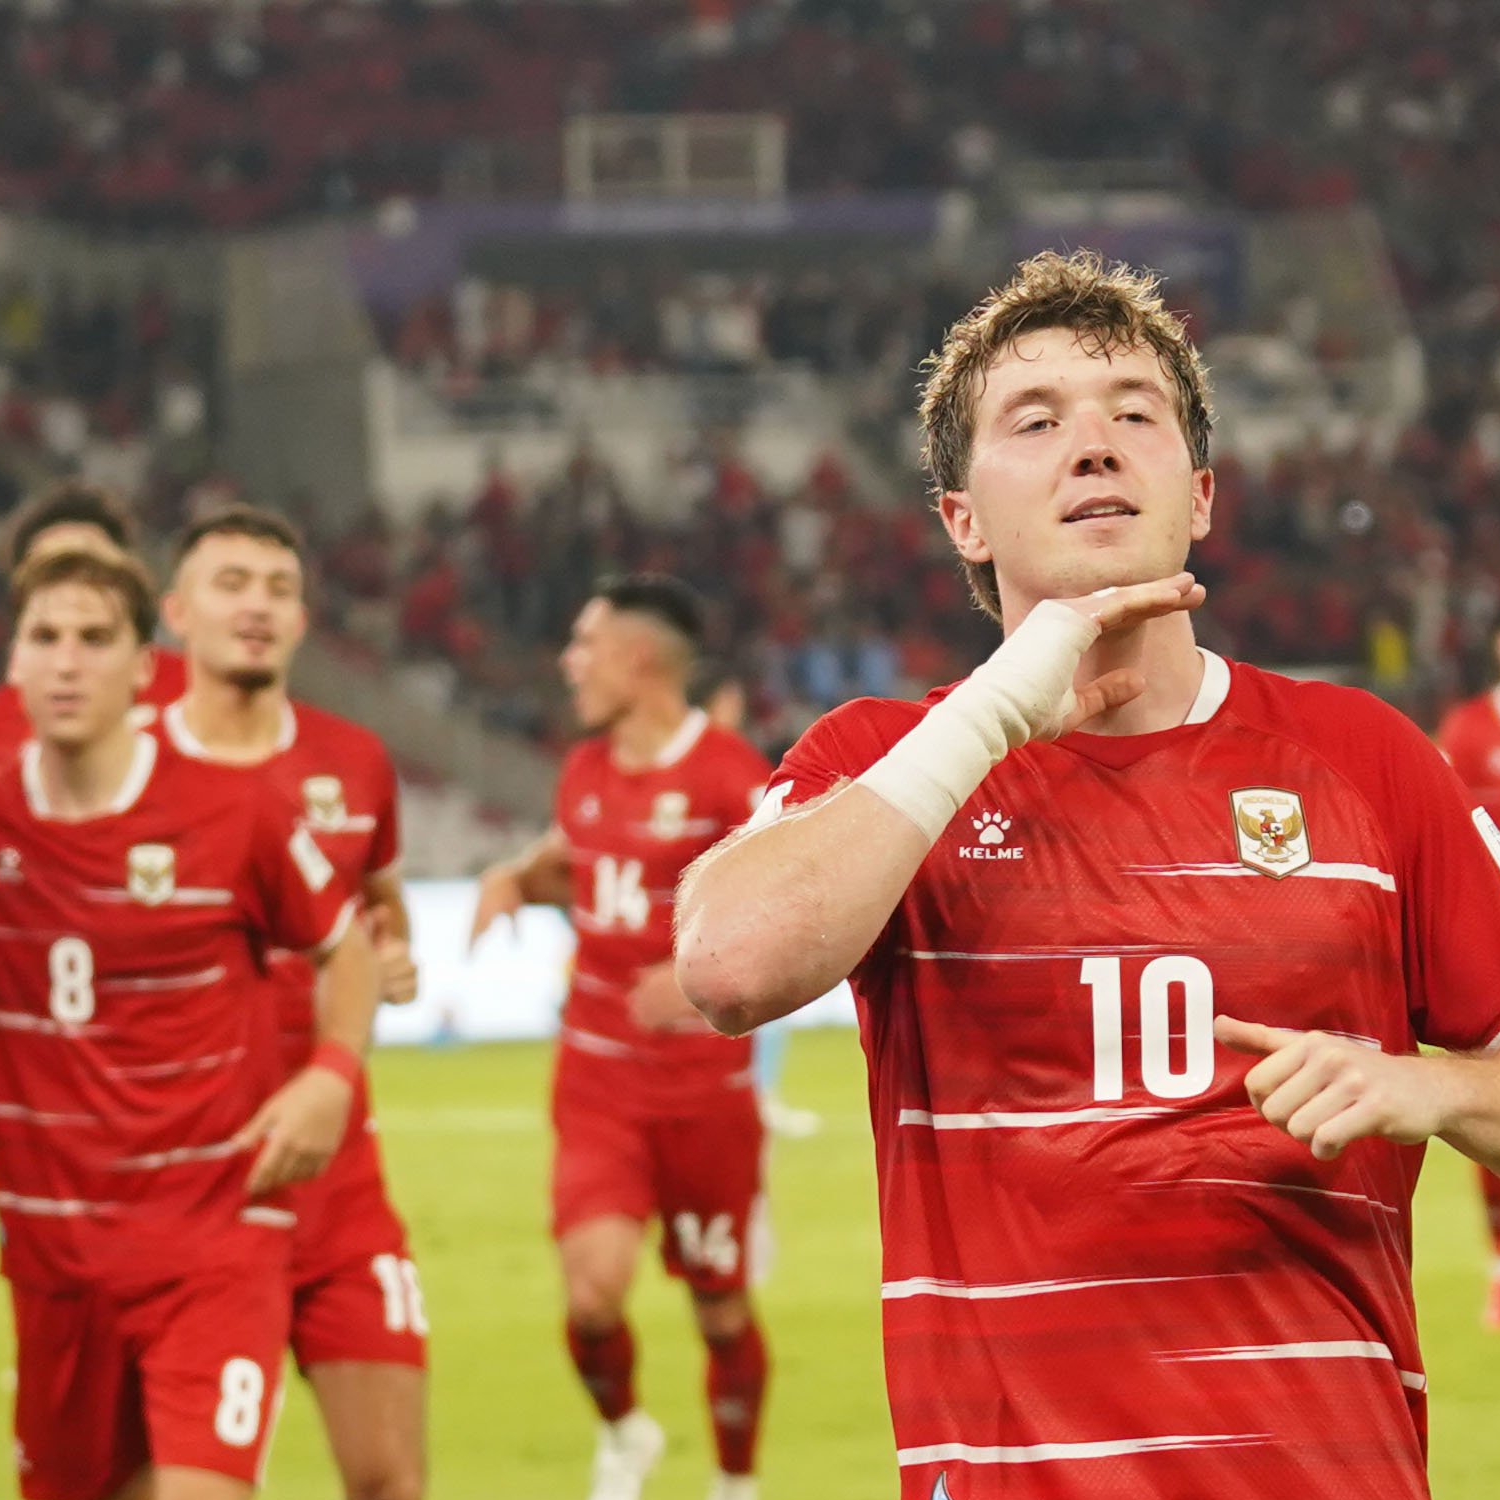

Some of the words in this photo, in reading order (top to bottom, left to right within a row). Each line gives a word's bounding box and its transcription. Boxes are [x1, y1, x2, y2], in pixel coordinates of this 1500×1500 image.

[595, 856, 649, 930] 14
[958, 846, 1024, 860] KELME
[48, 936, 95, 1024] 8
[1080, 955, 1215, 1101] 10
[675, 1211, 739, 1276] 14
[215, 1357, 264, 1446] 8
